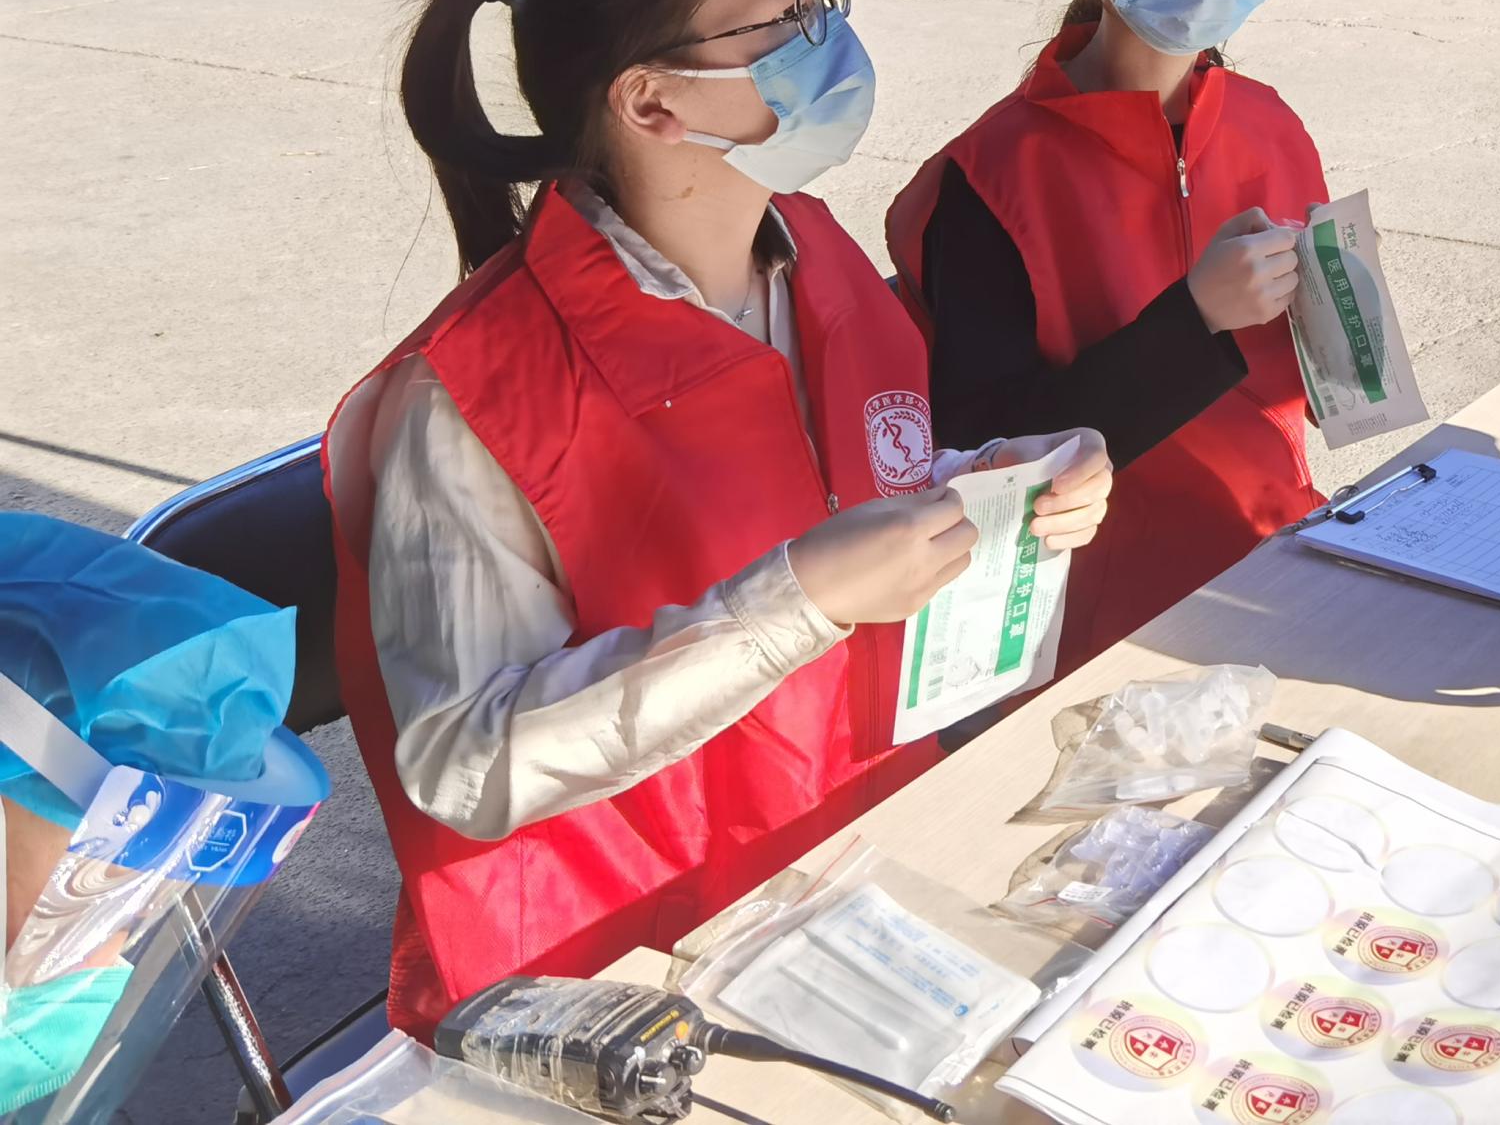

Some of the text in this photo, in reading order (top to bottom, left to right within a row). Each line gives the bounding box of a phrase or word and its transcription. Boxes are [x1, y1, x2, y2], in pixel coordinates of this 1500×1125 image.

[1327, 258, 1373, 368] 医用防护口罩
[1331, 911, 1376, 956] 抗原已检测
[1080, 999, 1135, 1051] 抗原已检测
[1270, 982, 1318, 1031] 抗原已检测
[1201, 1058, 1254, 1112] 抗原已检测
